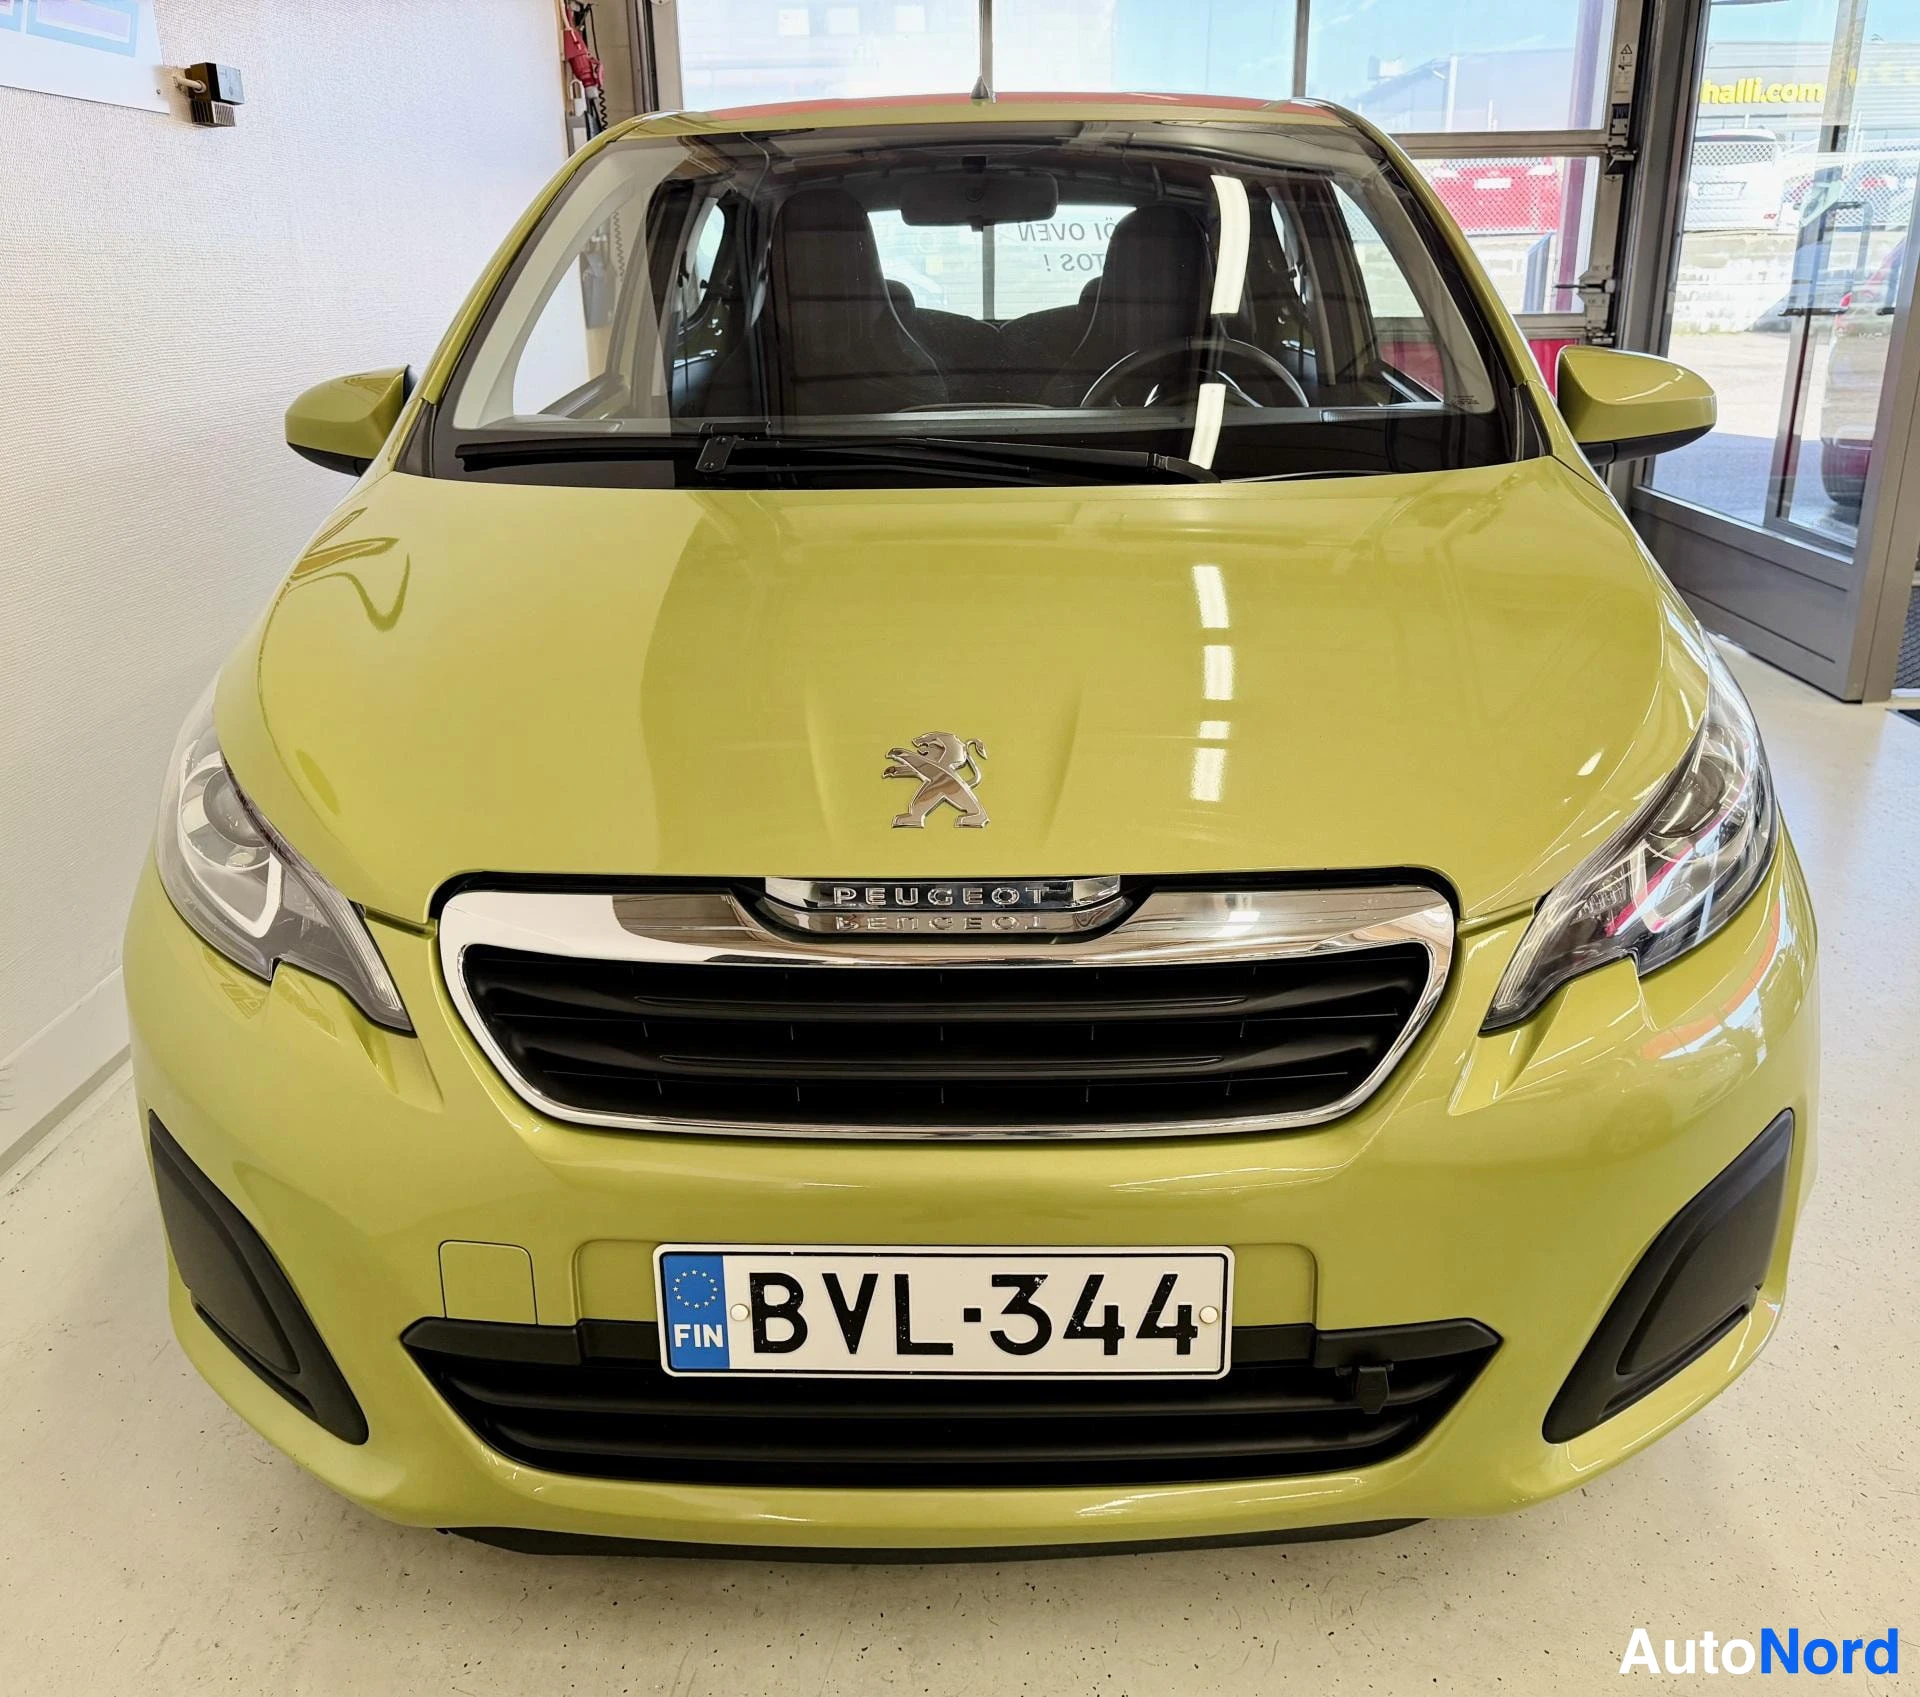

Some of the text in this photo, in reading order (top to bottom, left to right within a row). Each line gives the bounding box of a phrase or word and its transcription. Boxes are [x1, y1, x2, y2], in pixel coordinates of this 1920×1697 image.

[1700, 77, 1825, 105] halli.com
[833, 886, 1050, 906] PEUGEOT
[748, 1272, 1199, 1357] BVL-344
[673, 1323, 724, 1349] FIN
